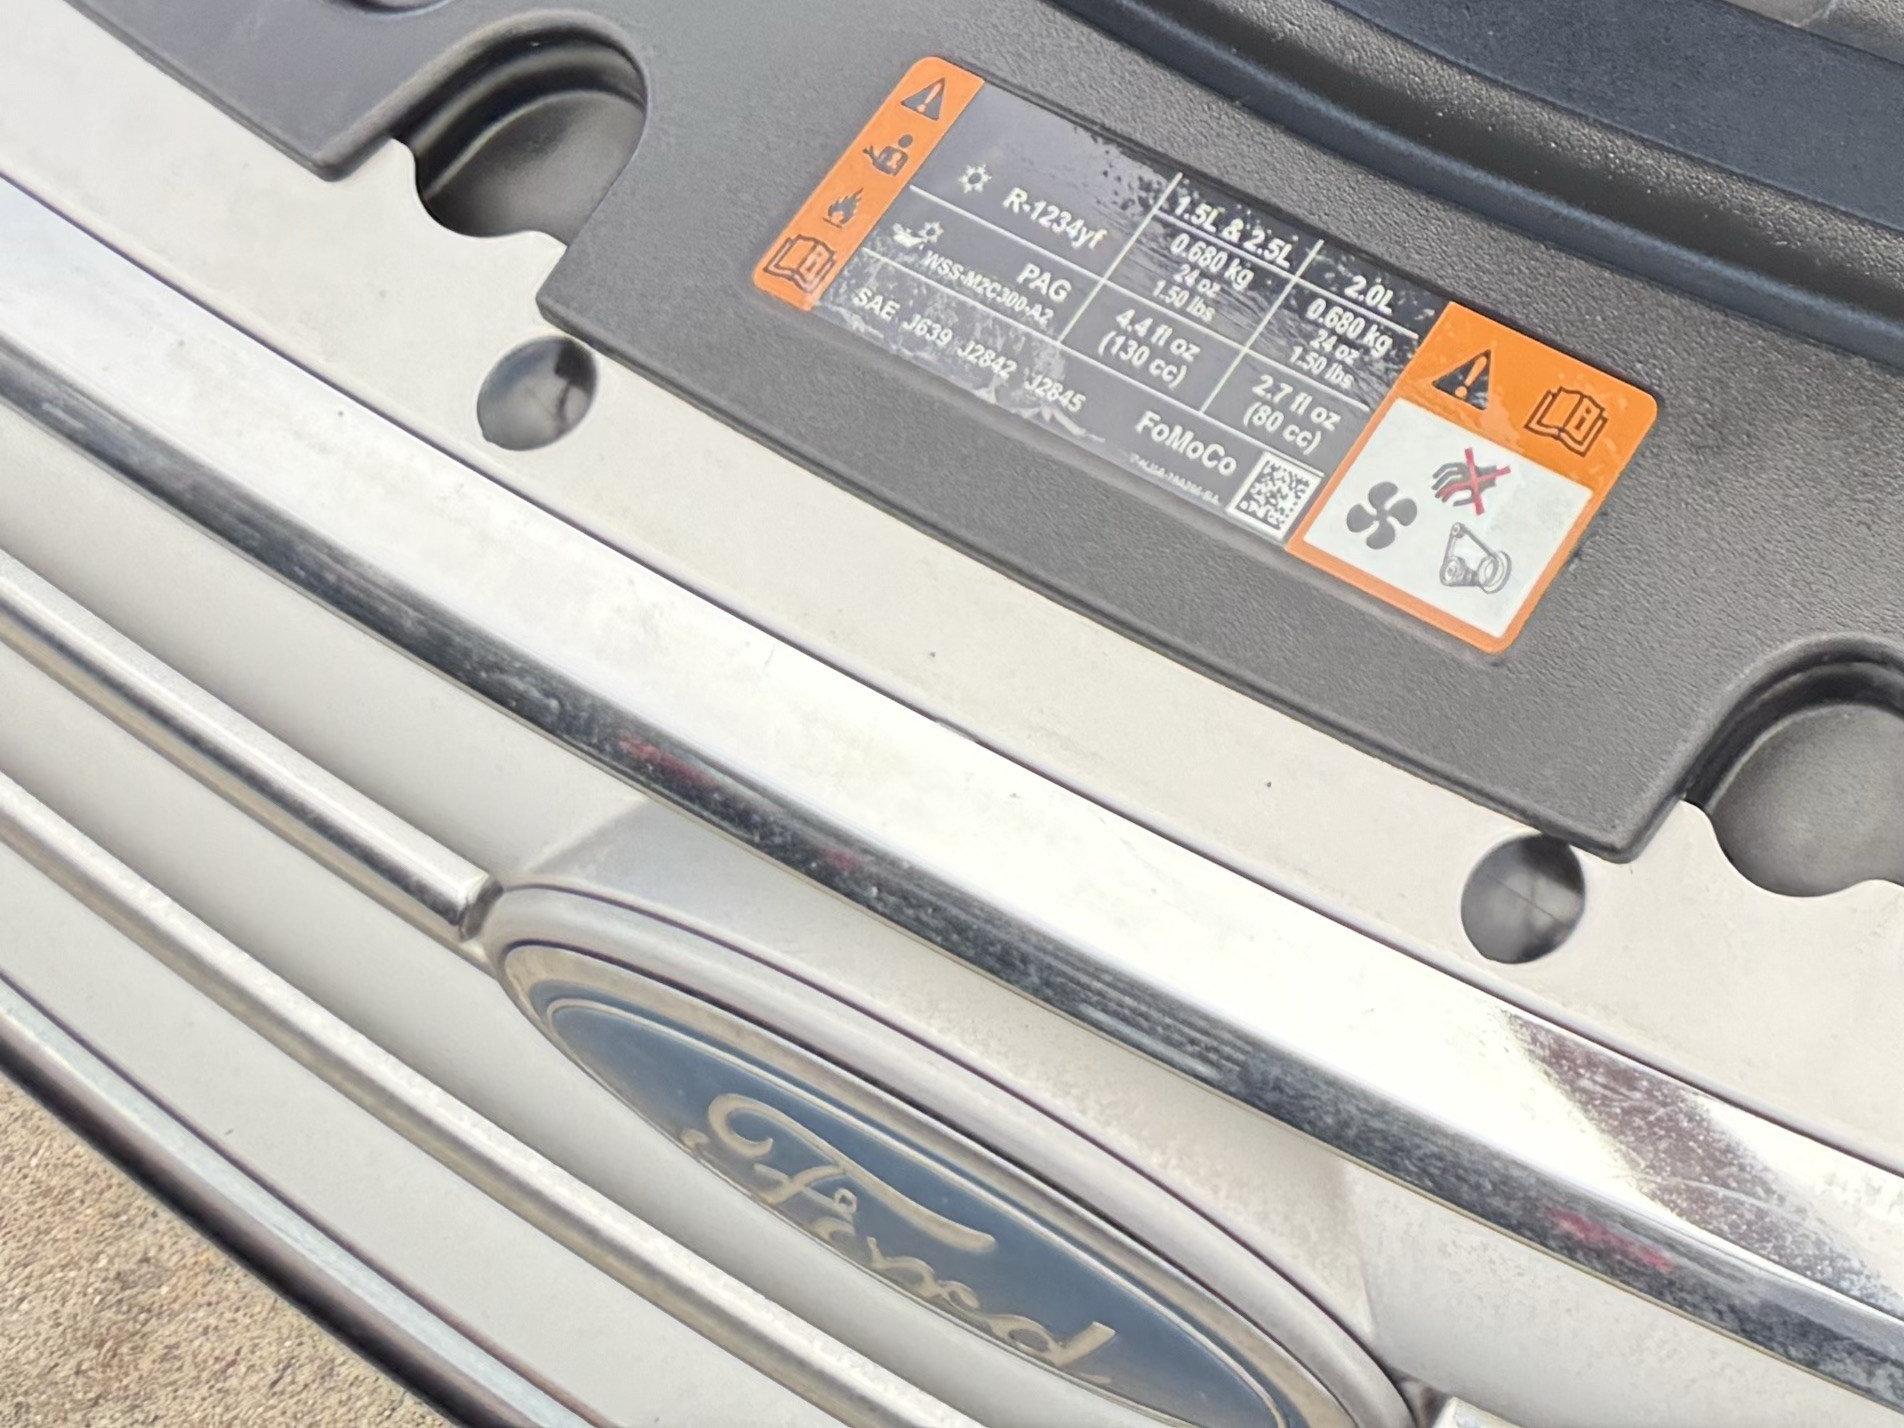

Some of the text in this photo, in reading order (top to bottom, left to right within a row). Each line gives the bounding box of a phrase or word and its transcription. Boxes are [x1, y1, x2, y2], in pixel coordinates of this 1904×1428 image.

[1003, 187, 1107, 249] R-1234yf
[1174, 195, 1293, 269] 1.5L & 2.5L
[1016, 263, 1071, 303] PAG
[1170, 233, 1254, 291] 0.680 kg
[1173, 264, 1221, 298] 24 oz
[1153, 280, 1216, 323] 1.50 lbs
[1344, 276, 1393, 315] 2.0L
[853, 287, 1086, 412] SAE J639 J2842 J2845
[1116, 309, 1200, 362] 4.4 fl oz
[1306, 299, 1393, 358] 0.680 kg
[1309, 330, 1359, 365] 24 oz
[1098, 331, 1187, 390] (130 cc)
[1290, 345, 1354, 389] 1.50 lbs
[1244, 402, 1322, 455] (80 cc)
[1252, 374, 1341, 431] 2.7 fl oz
[1134, 410, 1237, 476] FoMoCo
[681, 1091, 1116, 1367] Ford
